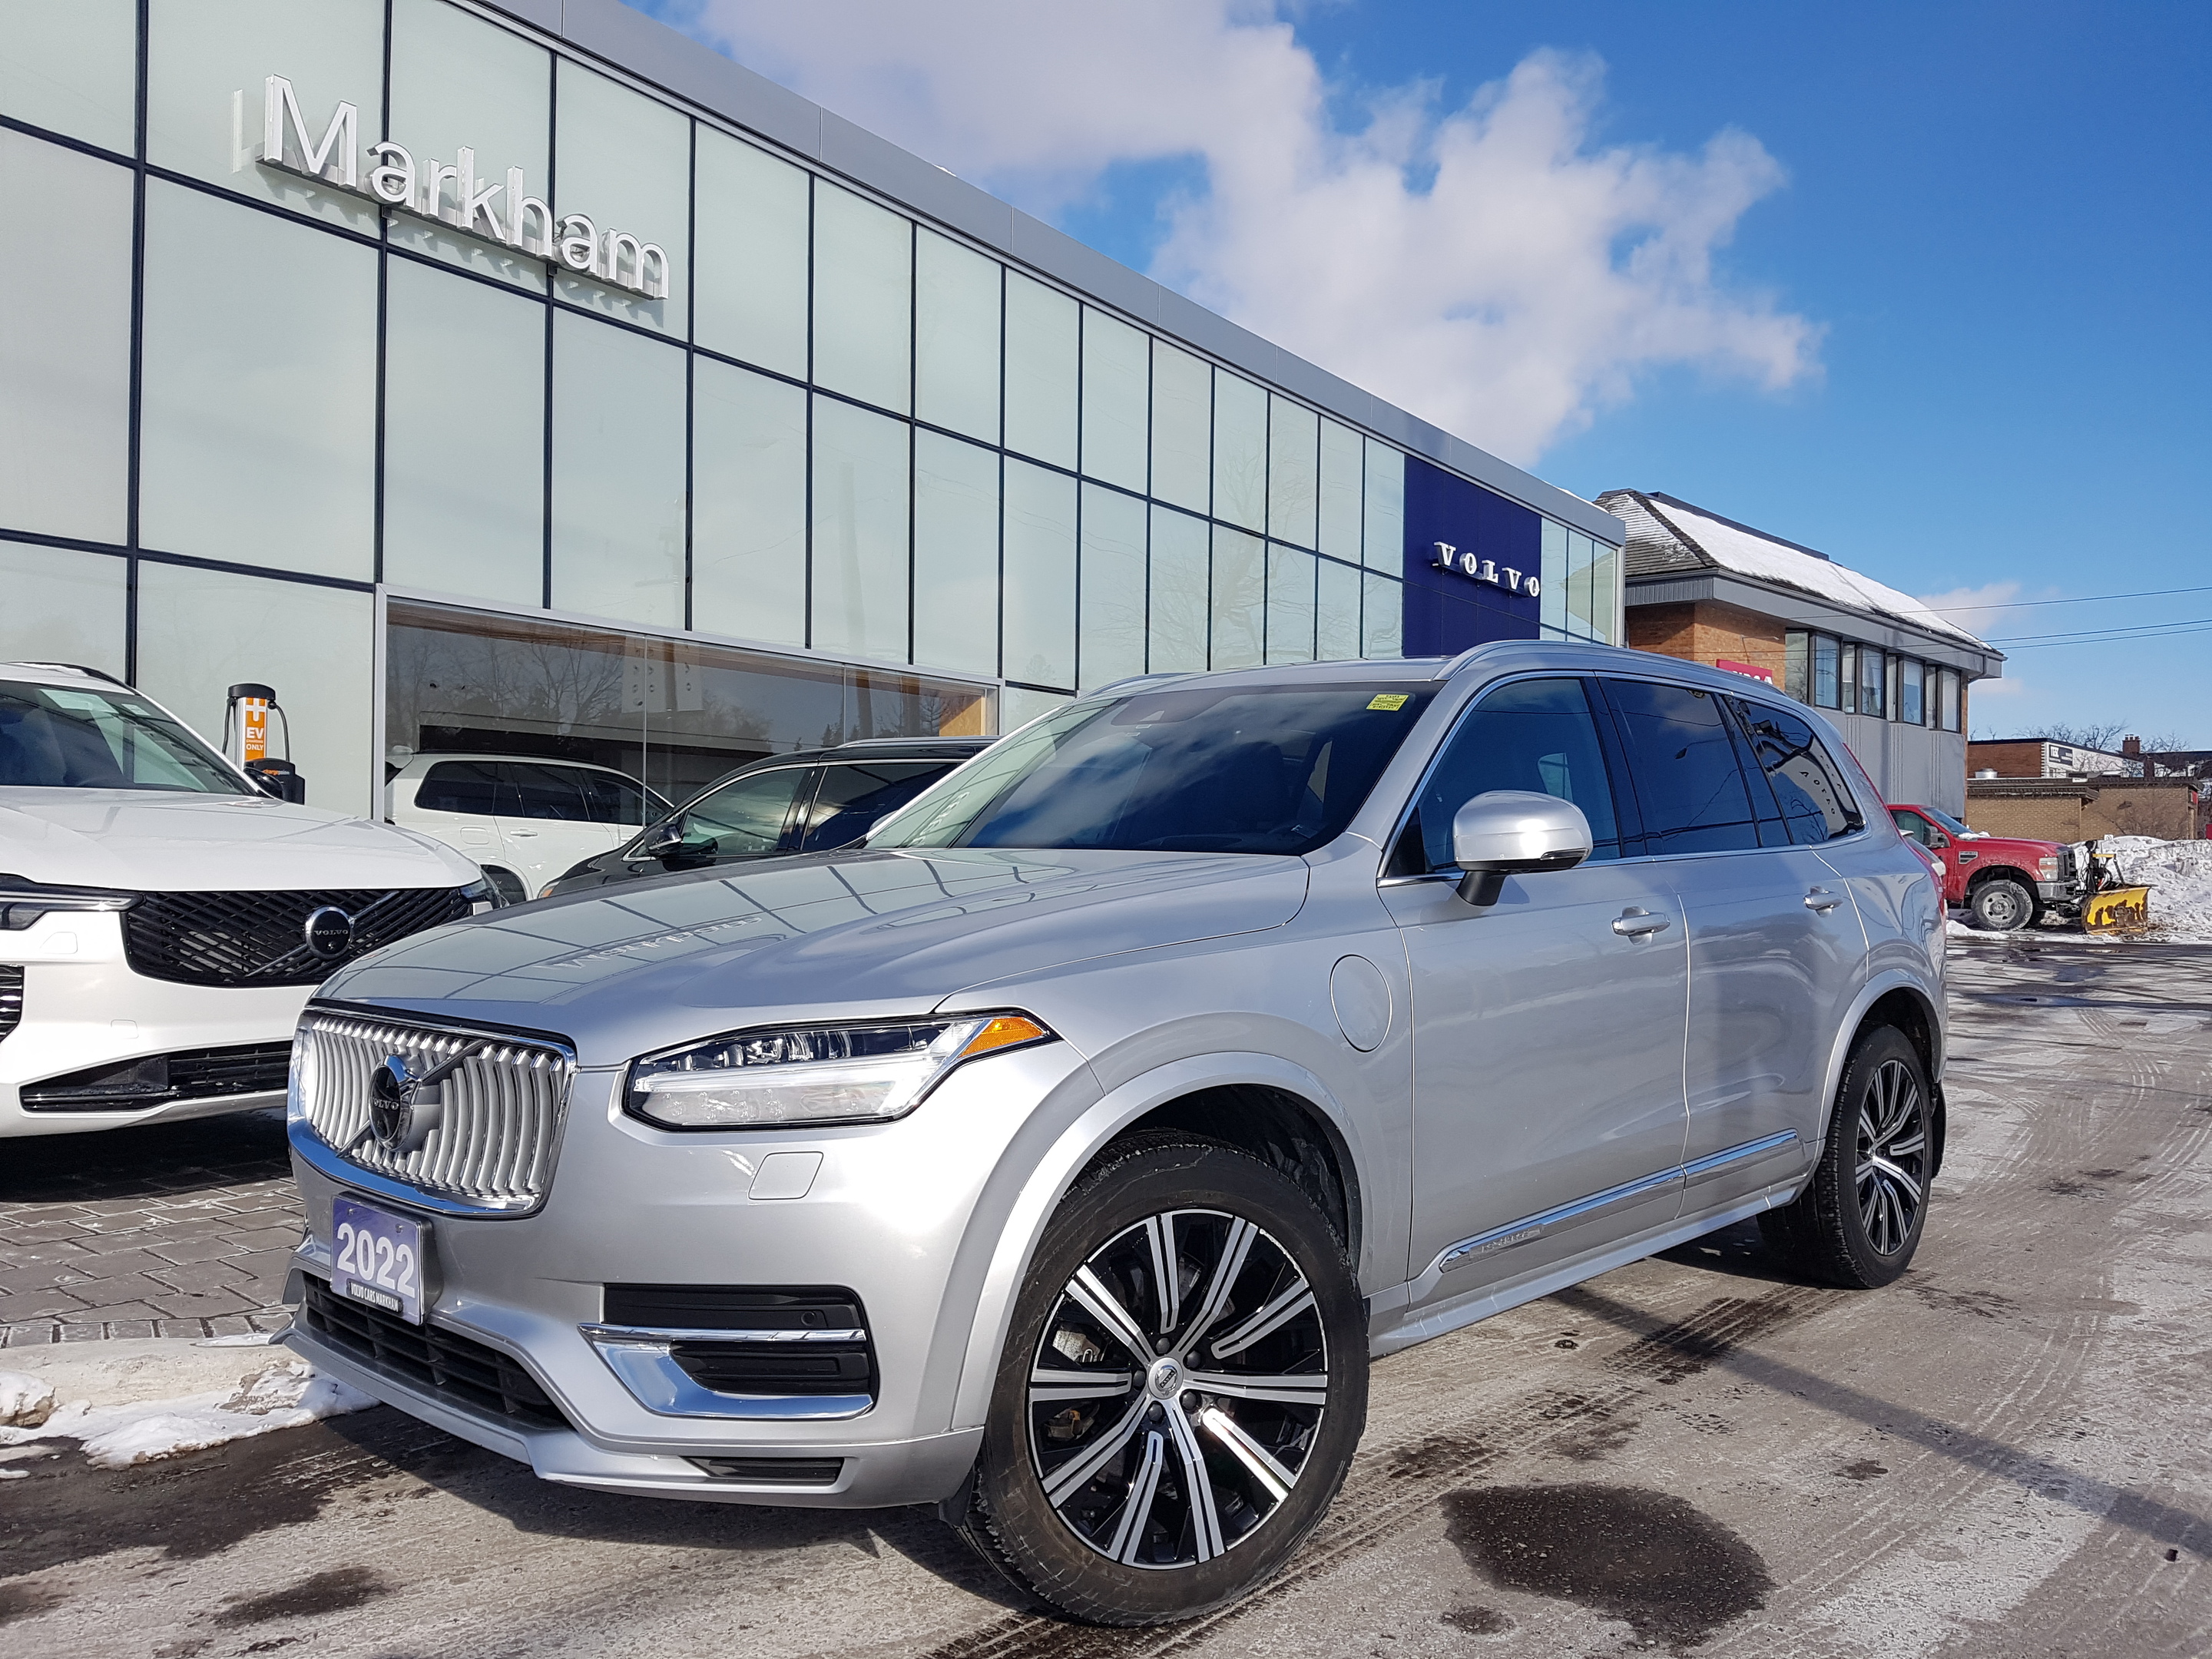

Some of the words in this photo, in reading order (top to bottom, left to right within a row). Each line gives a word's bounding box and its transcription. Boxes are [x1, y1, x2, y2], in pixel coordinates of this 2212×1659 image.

[263, 75, 670, 300] Markham
[1433, 541, 1540, 597] VOLVO
[247, 727, 264, 739] EV
[337, 1223, 415, 1298] 2022
[351, 1283, 363, 1299] VOLVO
[364, 1287, 376, 1303] CARS
[376, 1292, 399, 1313] MARKHAM
